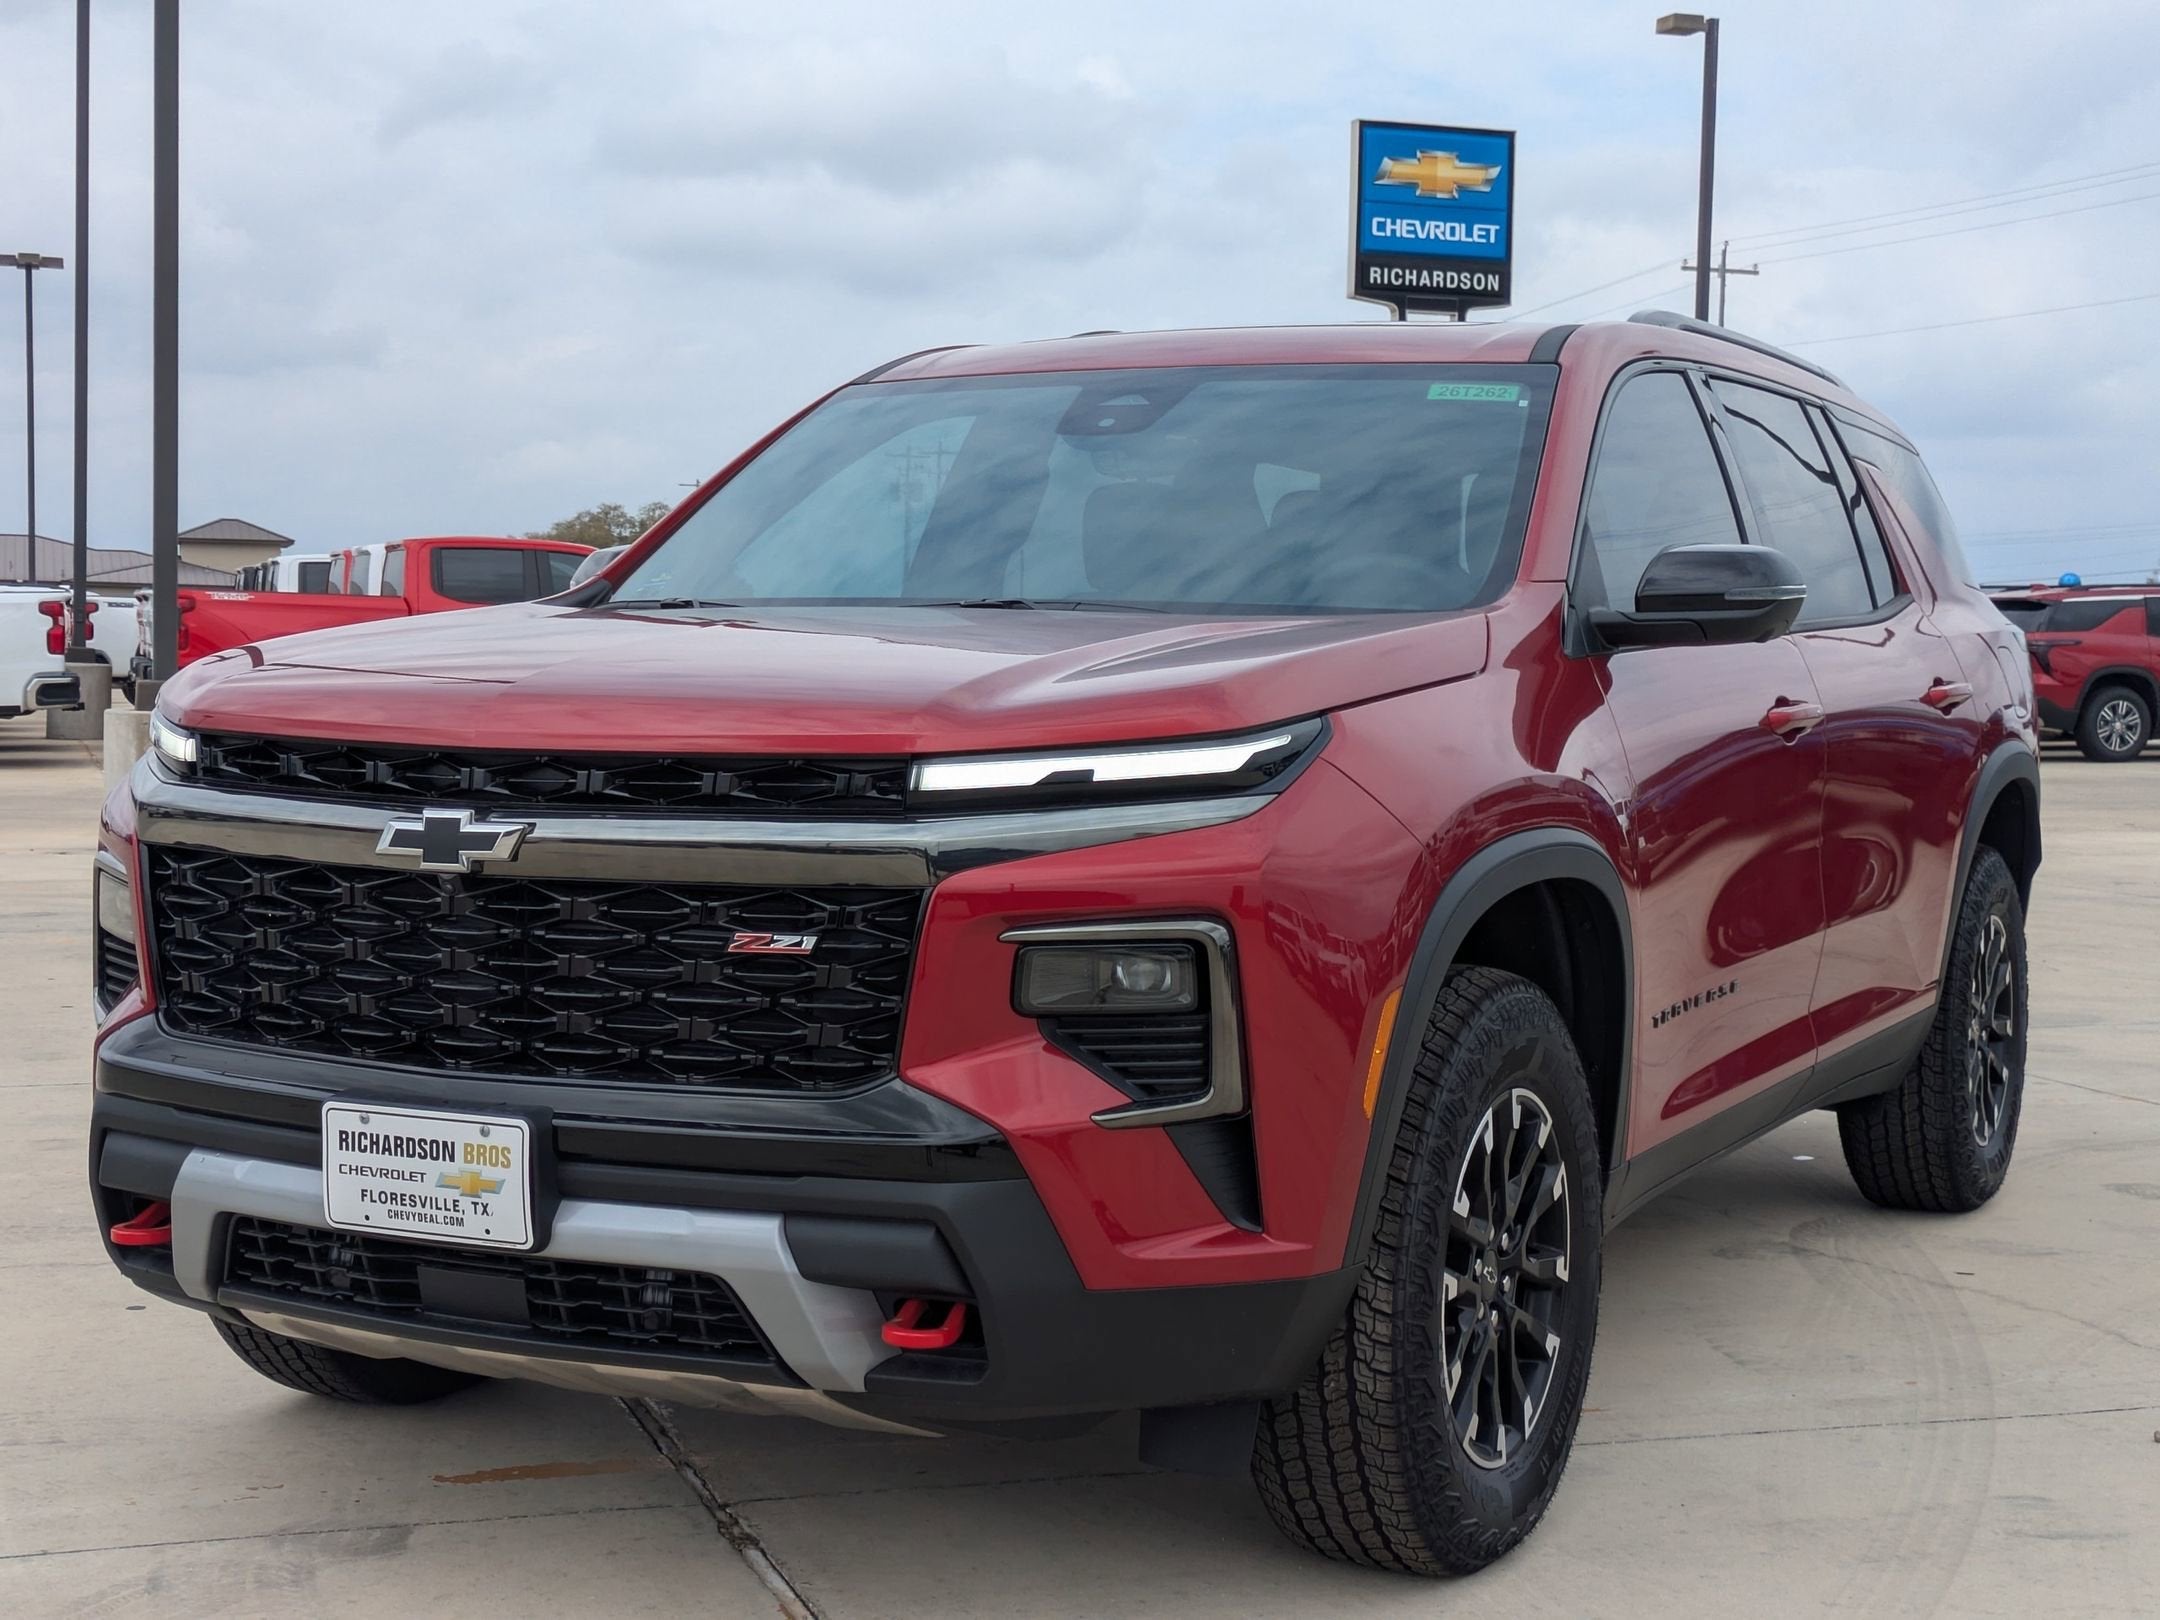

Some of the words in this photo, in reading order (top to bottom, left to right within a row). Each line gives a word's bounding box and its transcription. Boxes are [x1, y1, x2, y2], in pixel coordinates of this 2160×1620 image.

[1371, 217, 1500, 244] CHEVROLET
[1369, 266, 1500, 291] RICHARDSON
[728, 933, 818, 955] Z71
[1651, 978, 1742, 1029] TRAVERSE
[338, 1129, 456, 1163] RICHARDSON
[463, 1142, 512, 1169] BROS
[338, 1163, 427, 1183] CHEVROLET
[360, 1188, 466, 1216] FLORESVILLE,
[387, 1208, 465, 1228] CHEVYDEAL.COM
